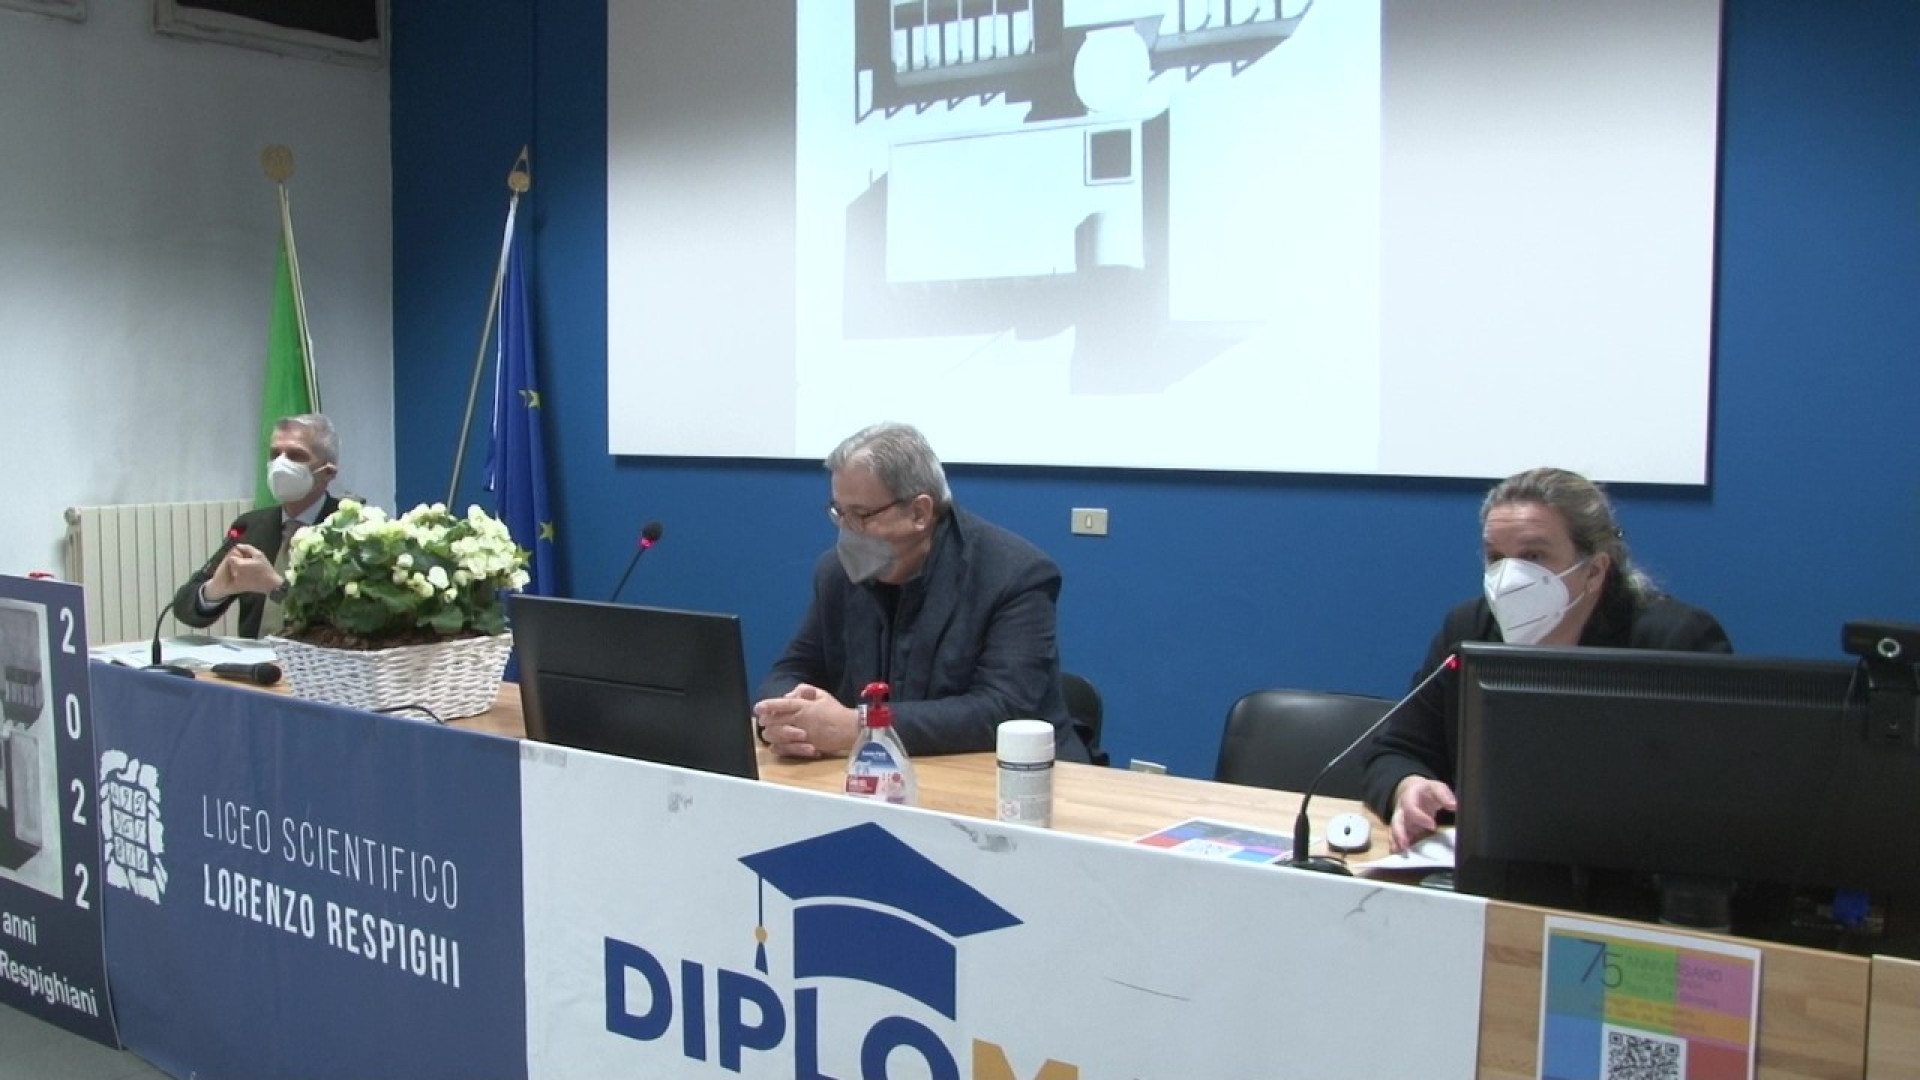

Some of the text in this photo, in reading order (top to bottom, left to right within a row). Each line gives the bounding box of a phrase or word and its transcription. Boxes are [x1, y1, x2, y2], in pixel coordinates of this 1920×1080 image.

[203, 795, 271, 854] LICEO
[283, 816, 458, 910] SCIENTIFICO
[2, 911, 37, 946] anni
[203, 863, 460, 988] LORENZO RESPIGHI
[0, 949, 99, 1018] Respighiani
[1580, 938, 1623, 989] 75
